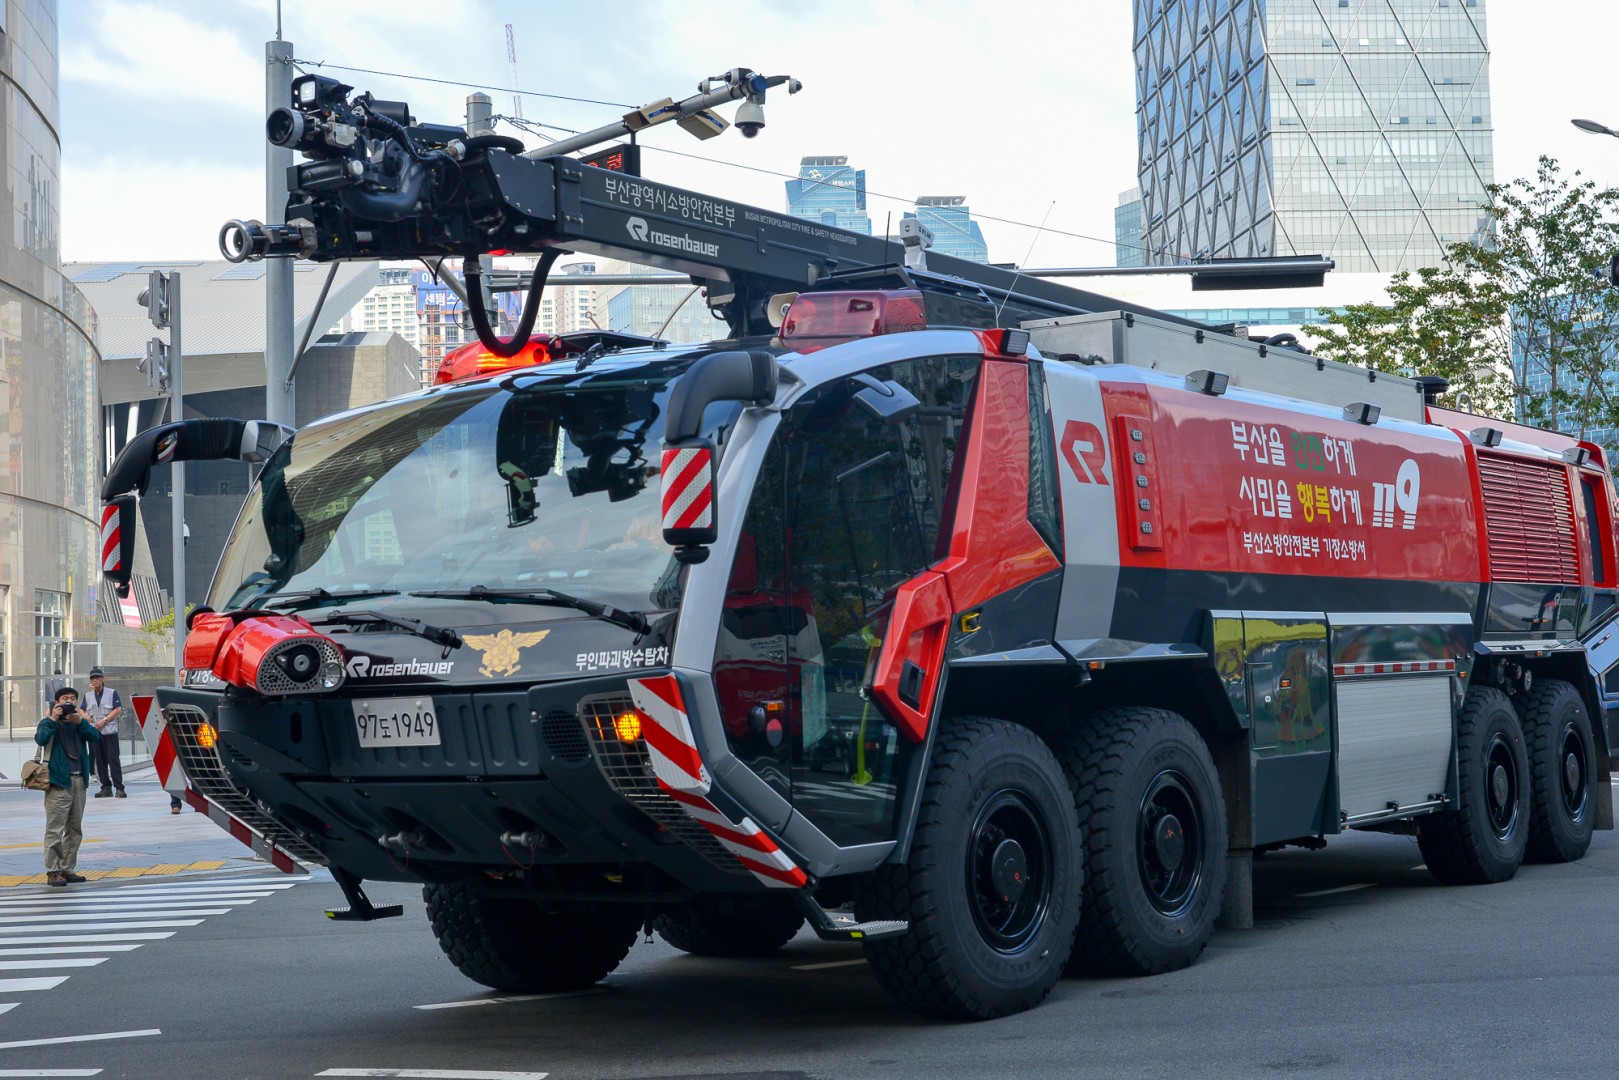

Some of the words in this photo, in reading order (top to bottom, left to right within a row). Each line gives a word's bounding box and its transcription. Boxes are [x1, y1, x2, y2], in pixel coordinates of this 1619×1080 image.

[605, 177, 736, 229] 부산광역시소방안전본부
[744, 211, 760, 222] BUSAN
[650, 230, 720, 258] rosenbauer
[1231, 421, 1287, 467] 부산을
[1290, 431, 1357, 477] 안전하게
[1239, 475, 1293, 519] 시민을
[1296, 481, 1363, 526] 행복하게
[1372, 458, 1421, 530] 119
[1243, 531, 1321, 558] 부산소방안전본부
[1322, 538, 1367, 561] 기장소방서
[370, 658, 455, 677] rosenbauer
[575, 646, 669, 672] 무인파괴방수탑차
[357, 711, 434, 740] 97도1949
